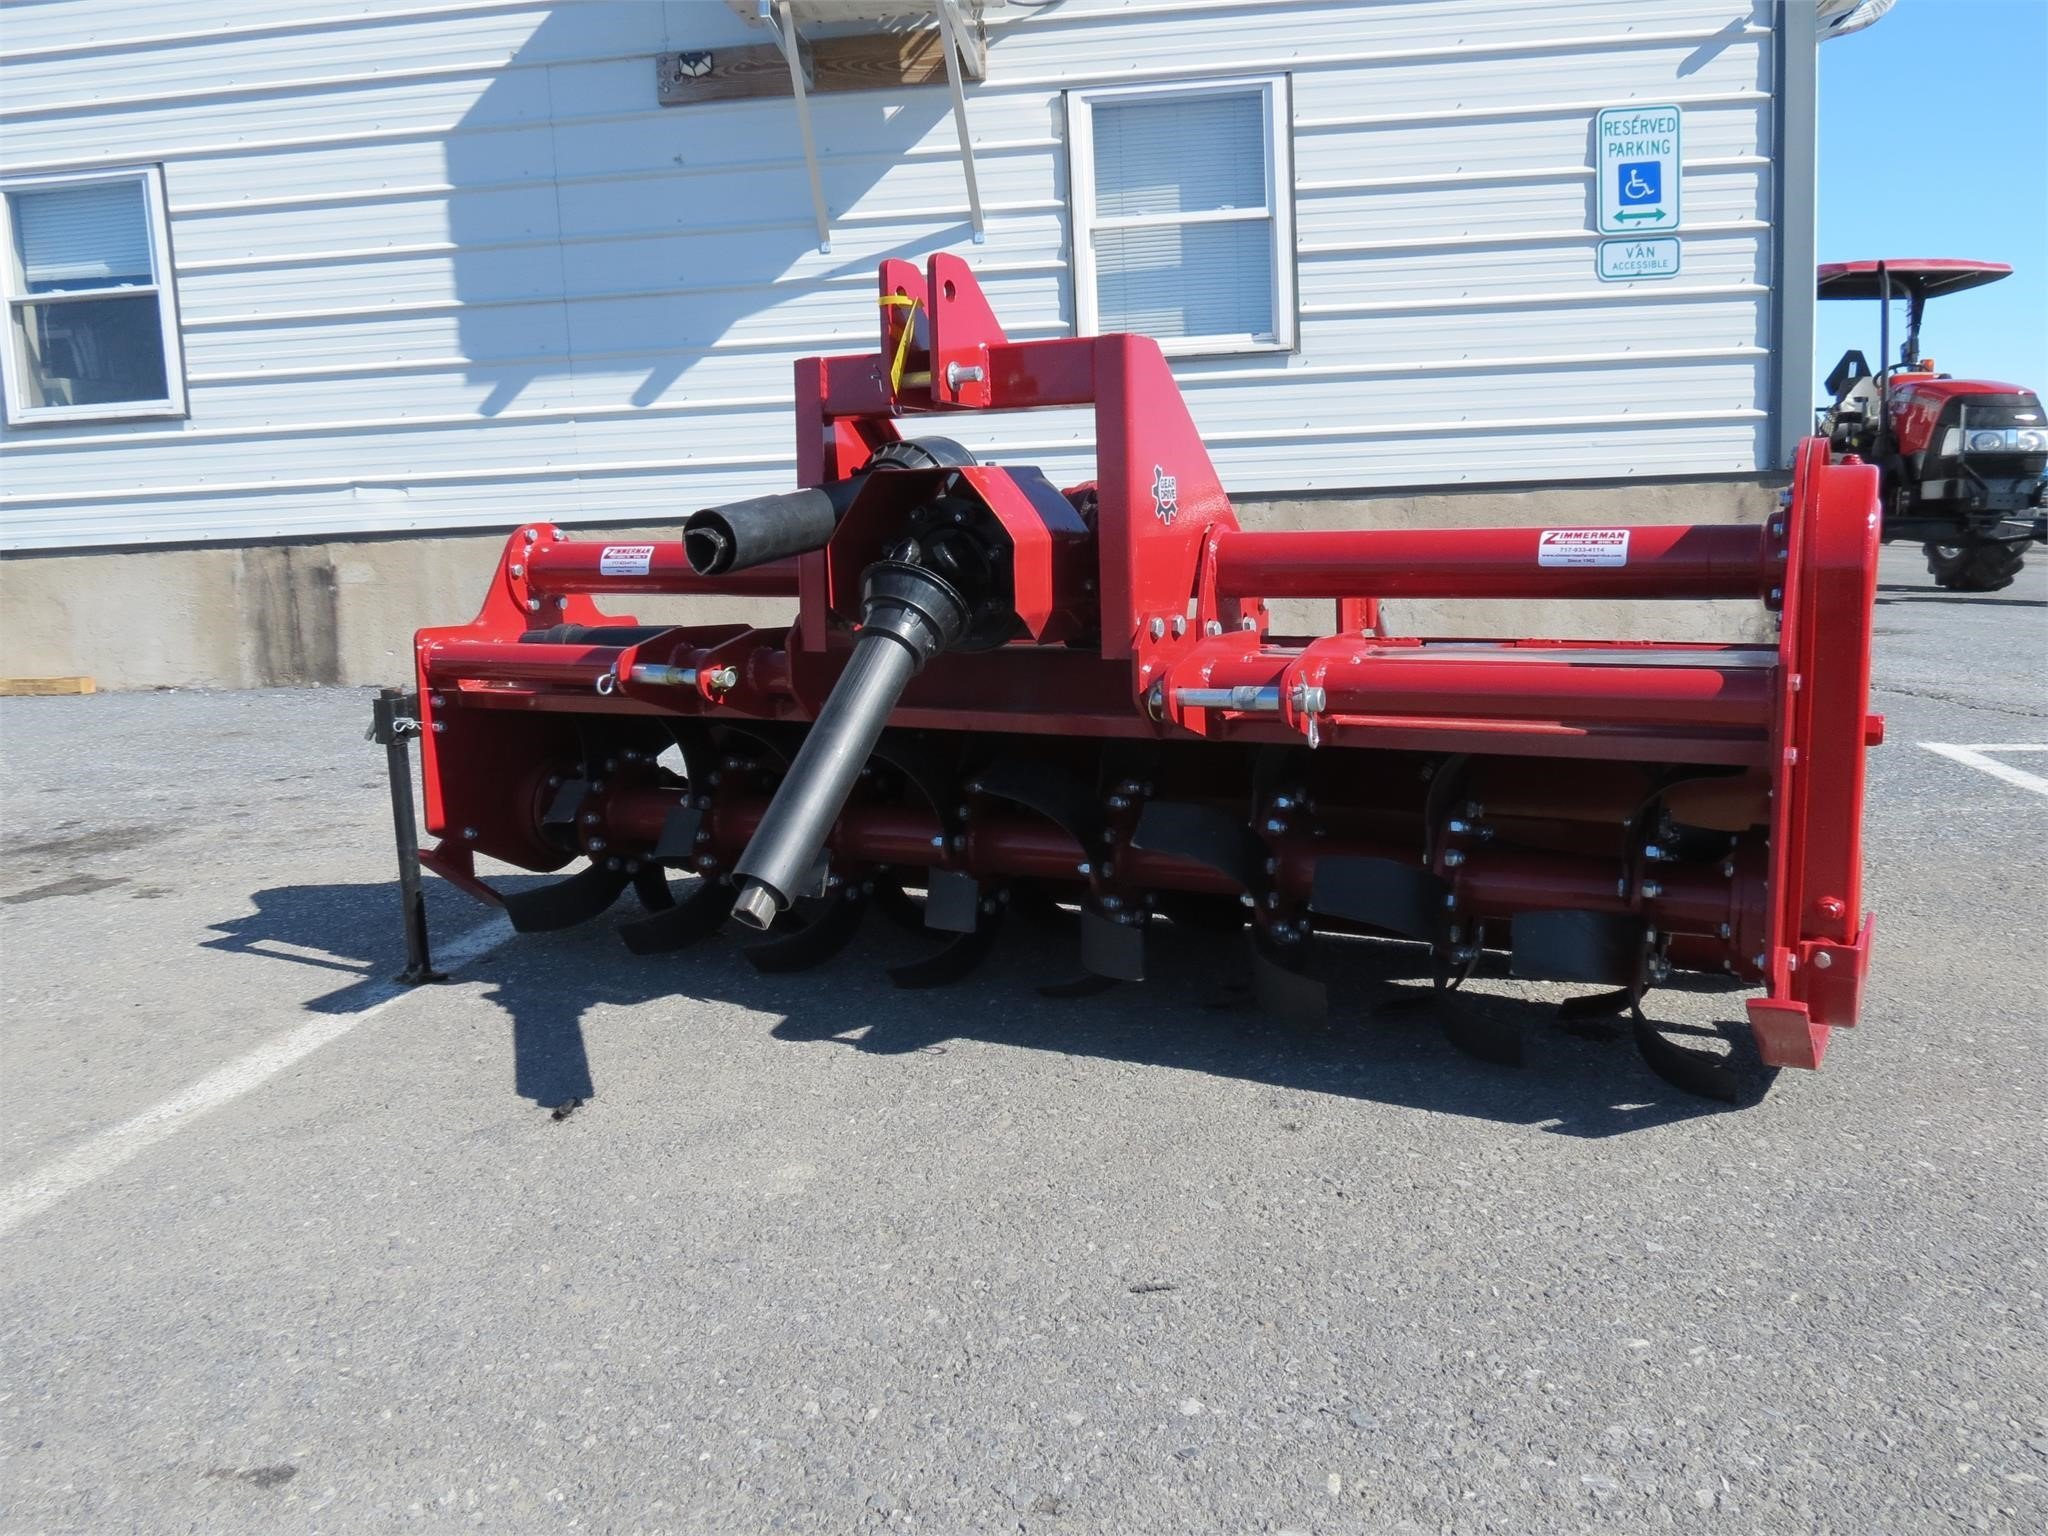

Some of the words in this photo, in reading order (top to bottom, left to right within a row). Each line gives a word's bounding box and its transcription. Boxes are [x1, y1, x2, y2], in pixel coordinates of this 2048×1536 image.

[1604, 117, 1676, 137] RESERVED
[1608, 139, 1671, 157] PARKING
[1625, 246, 1656, 259] VAN
[1612, 259, 1669, 271] ACCESSIBLE
[1160, 478, 1175, 488] GEAR
[1160, 489, 1176, 500] DRIVE
[1542, 531, 1626, 545] ZIMMERMAN
